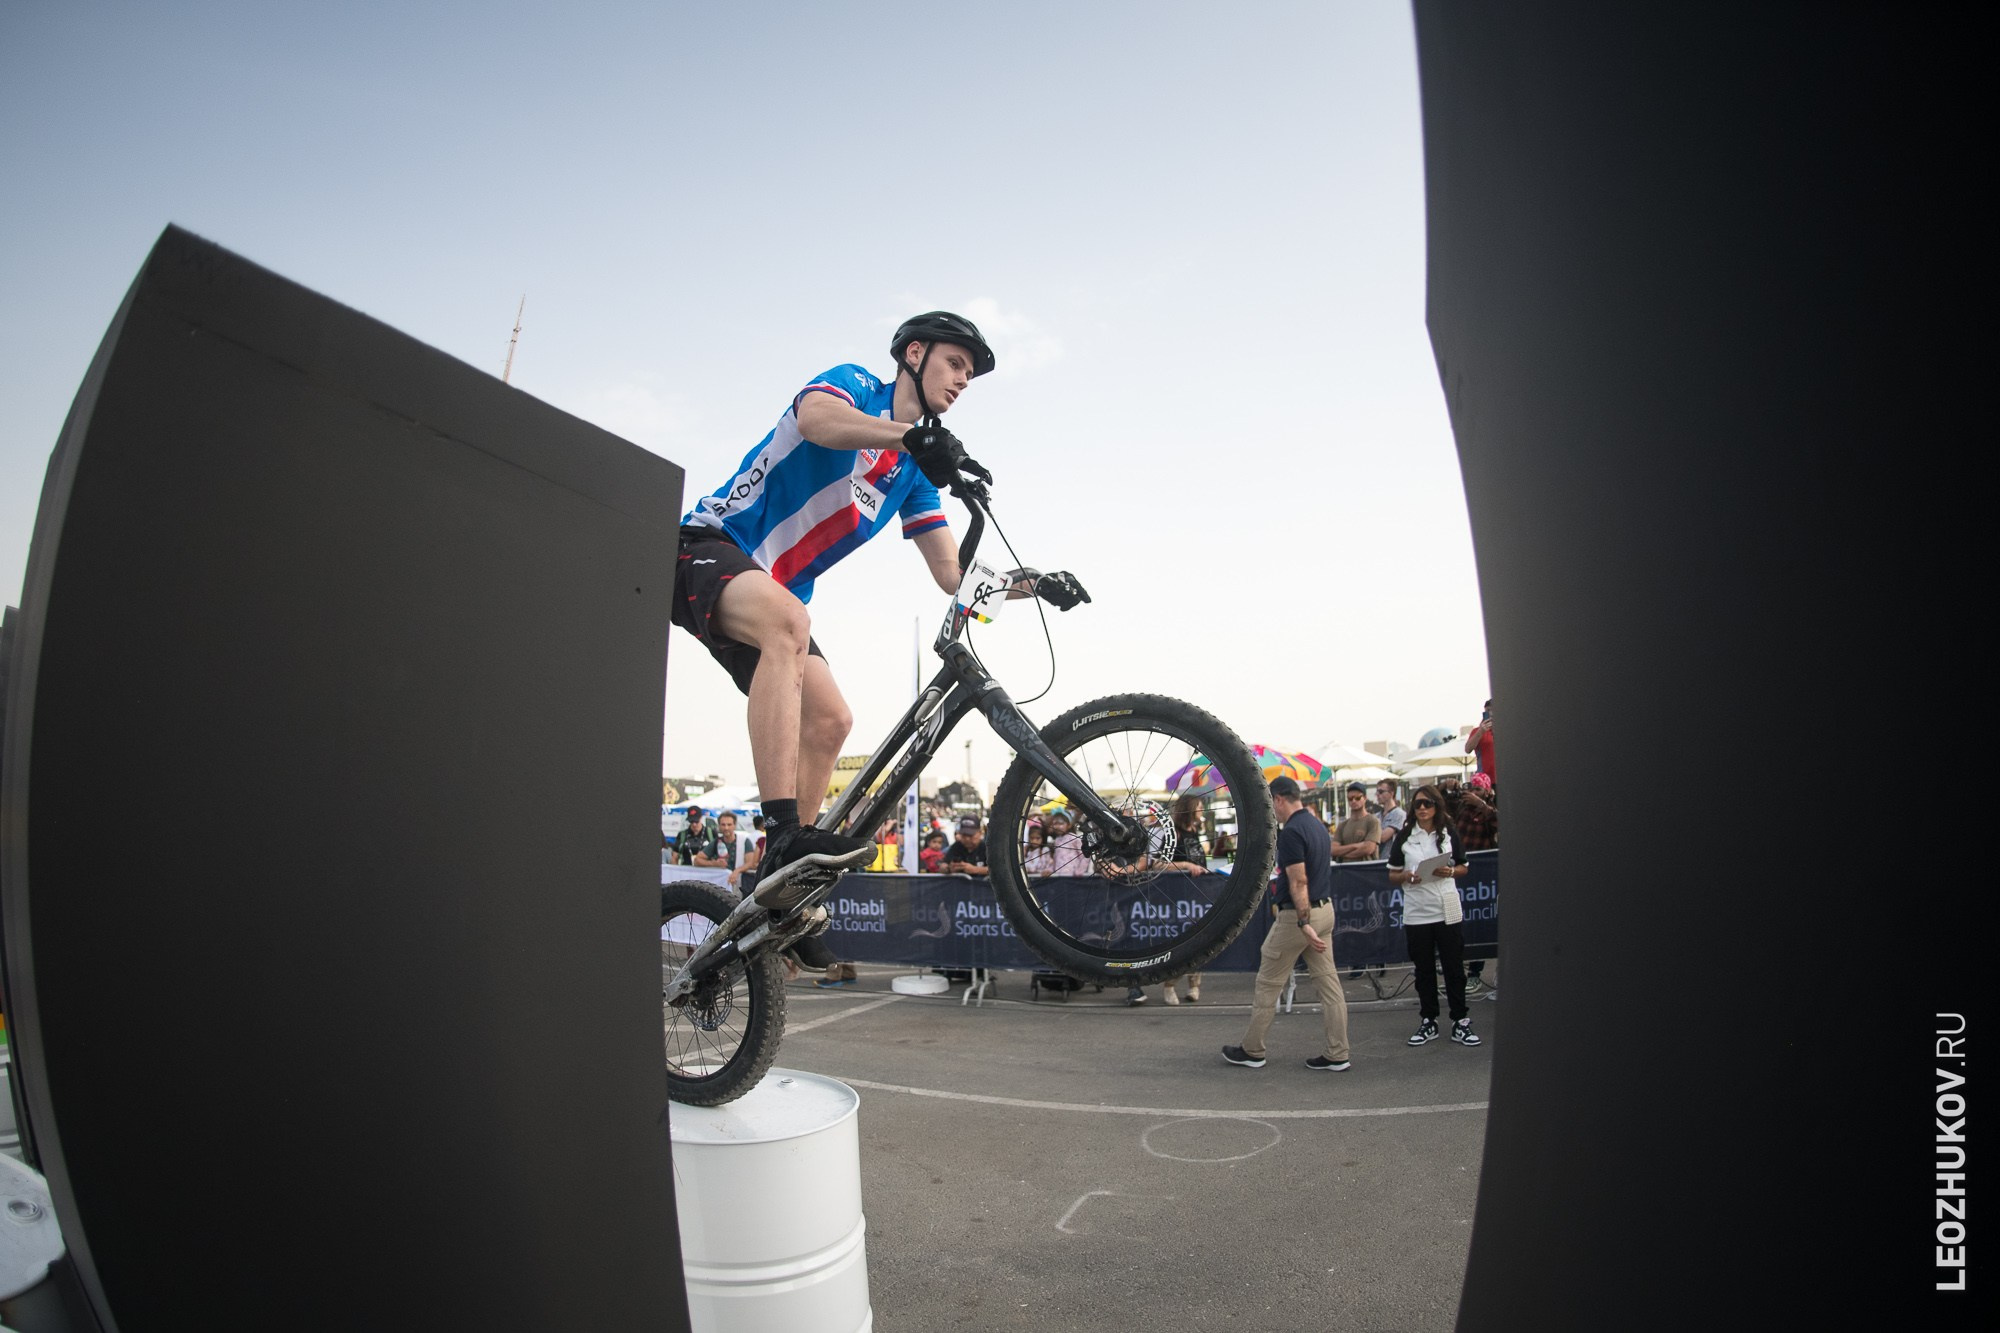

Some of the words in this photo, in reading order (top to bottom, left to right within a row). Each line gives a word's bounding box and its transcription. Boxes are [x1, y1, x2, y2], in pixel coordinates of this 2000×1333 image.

[839, 898, 884, 916] Dhabi
[955, 901, 991, 919] Abu
[1130, 901, 1171, 919] Abu
[844, 917, 886, 933] Council
[955, 921, 998, 938] Sports
[1130, 922, 1179, 940] Sports
